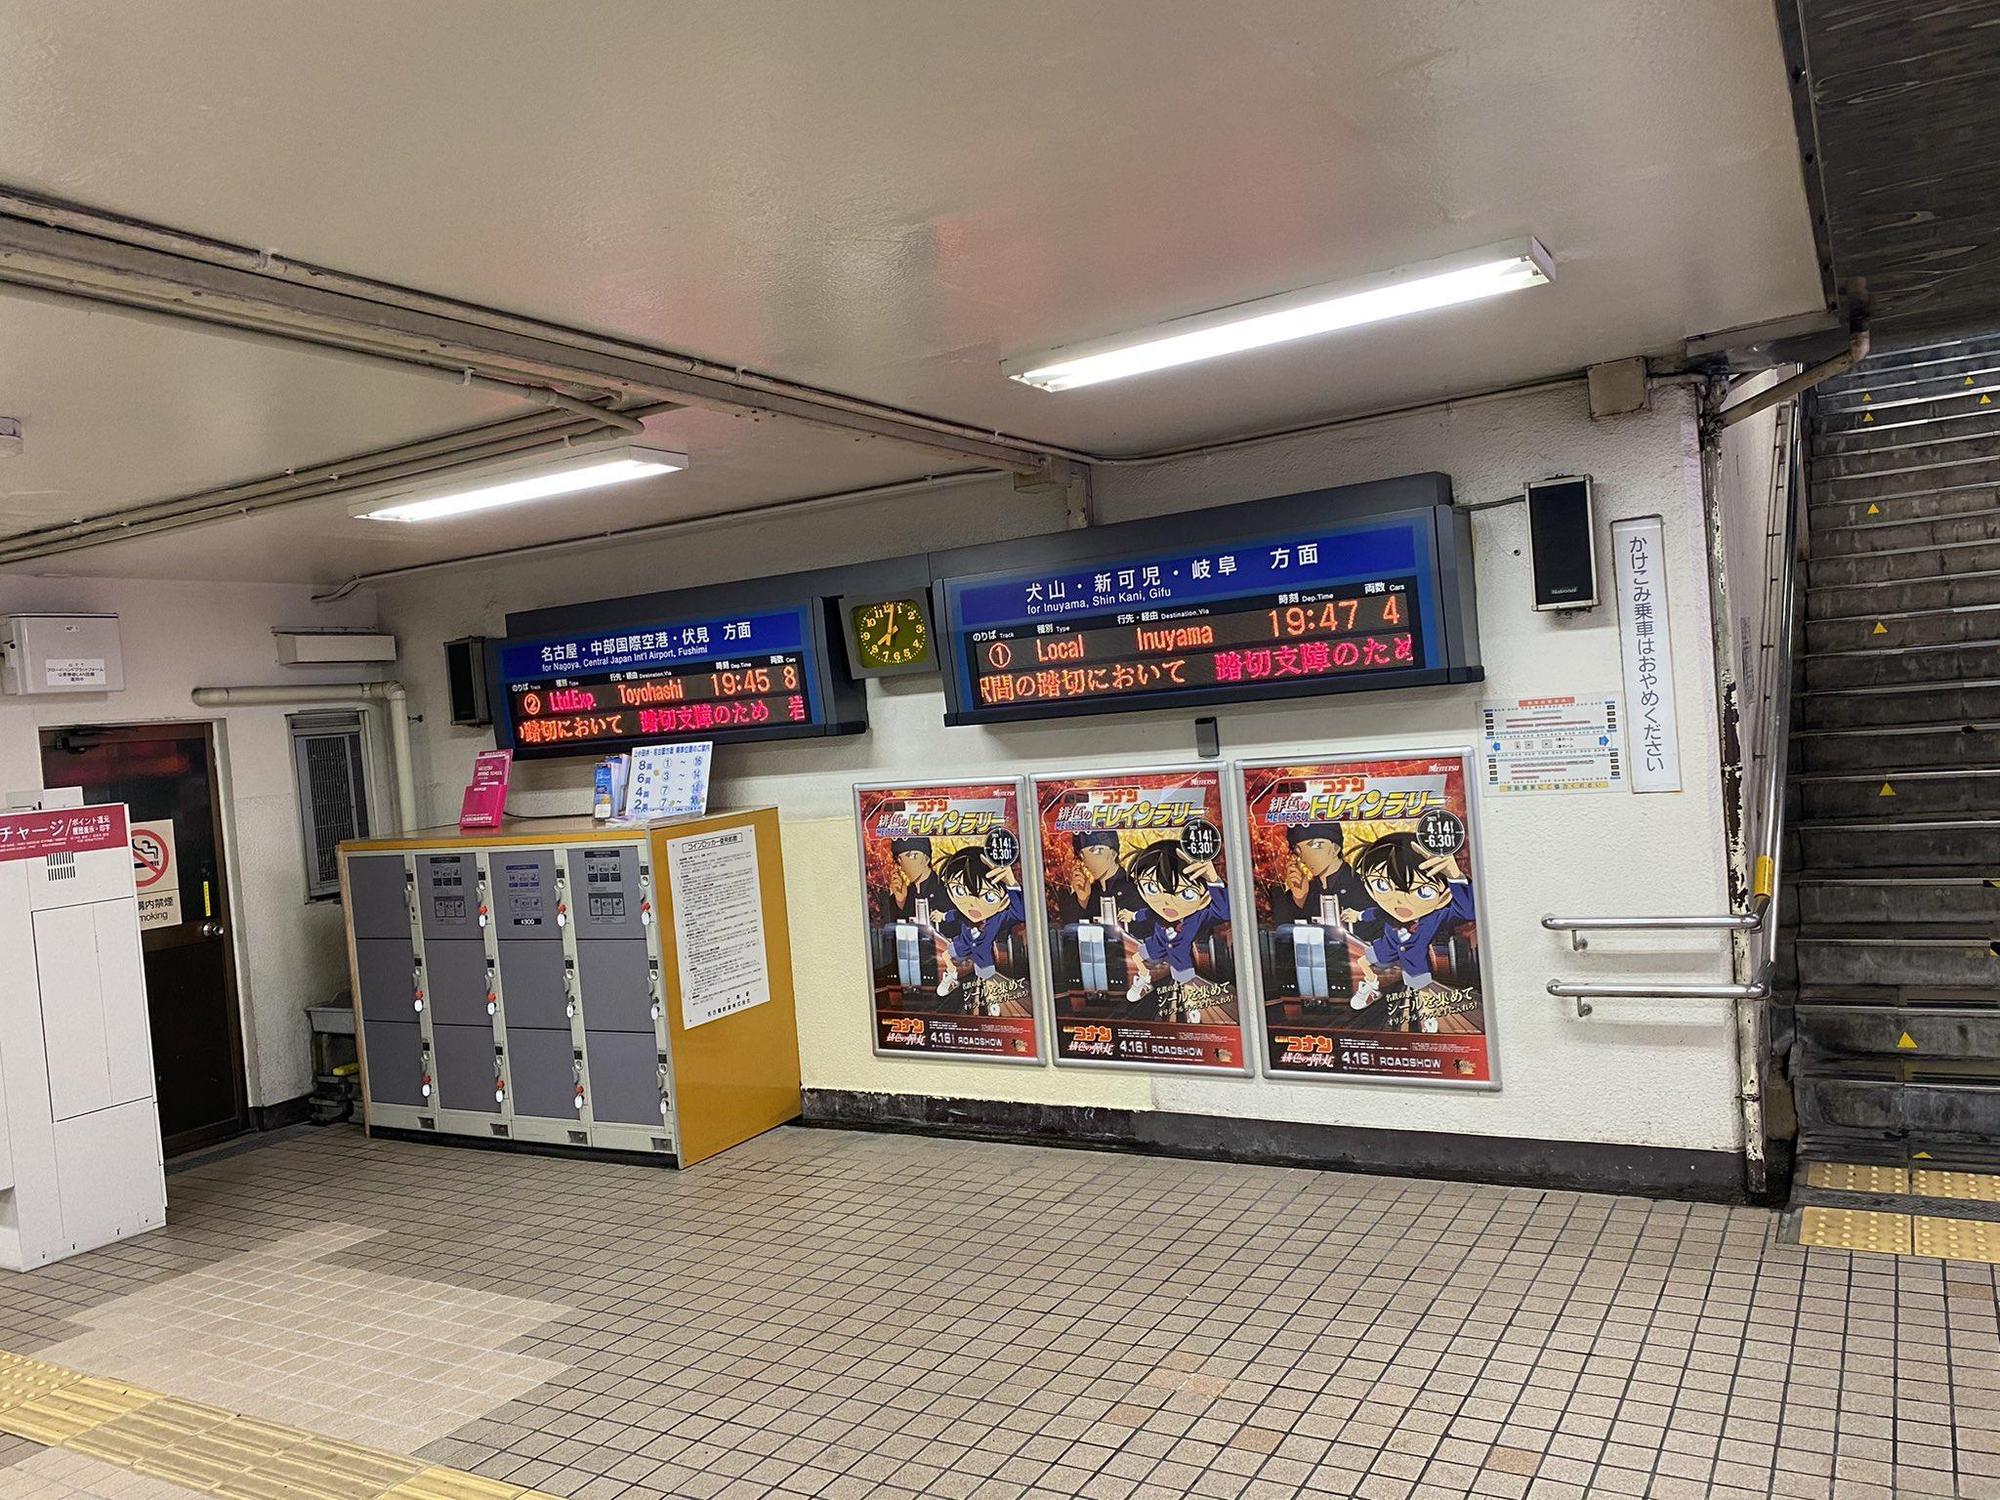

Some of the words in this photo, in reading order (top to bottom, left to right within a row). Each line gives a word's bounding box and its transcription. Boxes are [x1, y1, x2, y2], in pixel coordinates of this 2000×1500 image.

[1026, 556, 1237, 602] 犬山・新可児・岐阜
[1270, 543, 1319, 570] 方面
[1027, 603, 1041, 614] for
[1044, 599, 1089, 613] Inuyama,
[1092, 594, 1116, 606] Shin
[1119, 591, 1146, 603] Kani,
[1149, 588, 1171, 599] Gifu
[875, 609, 884, 619] 11
[907, 611, 915, 620] 2
[972, 630, 997, 641] のりば
[1036, 624, 1054, 634] 種別
[1056, 626, 1070, 634] Type
[1117, 611, 1159, 625] 行先・経由
[1278, 593, 1299, 605] 時刻
[1364, 582, 1386, 594] 両数
[1389, 583, 1405, 592] Cars
[866, 618, 876, 628] 10
[916, 624, 923, 634] 3
[1036, 634, 1085, 663] Local
[1137, 624, 1214, 652] Inuyama
[1268, 600, 1359, 638] 19:47
[1383, 595, 1401, 625] 4
[541, 626, 710, 662] 名古屋・中部国際空港・伏見
[723, 621, 752, 641] 方面
[863, 632, 870, 641] 9
[912, 639, 920, 648] 4
[871, 645, 879, 653] 8
[882, 651, 889, 660] 7
[893, 651, 900, 660] 6
[903, 648, 911, 657] 5
[1629, 536, 1664, 772] かけこみ乗車はおやめください
[542, 663, 552, 672] for
[553, 661, 582, 672] Nagoya,
[583, 656, 609, 668] Central
[610, 654, 633, 666] Japan
[649, 649, 677, 662] Airport,
[678, 645, 708, 657] Fushimi
[512, 682, 529, 692] のりば
[618, 679, 685, 706] Toyohashi
[710, 668, 771, 697] 19:45
[783, 665, 797, 690] 8
[1322, 777, 1365, 793] コナン
[1103, 790, 1138, 803] コナン
[917, 800, 948, 812] コナン
[1269, 797, 1309, 812] 緋色の
[1309, 790, 1447, 820] トレインラリー
[908, 810, 1006, 835] トレインラリー
[1092, 801, 1205, 828] トレインラリー
[1158, 981, 1230, 1007] シールを集めて
[1388, 986, 1474, 1015] シールを集めて
[891, 1018, 924, 1033] コナン
[1073, 1025, 1112, 1041] コナン
[930, 1032, 951, 1043] 4.16
[958, 1037, 1003, 1047] ROADSHOW
[1287, 1035, 1333, 1053] コナン
[1119, 1040, 1144, 1053] 4.16
[1152, 1045, 1203, 1057] ROADSHOW
[1341, 1051, 1370, 1065] 4.16
[1379, 1056, 1441, 1068] ROADSHOW
